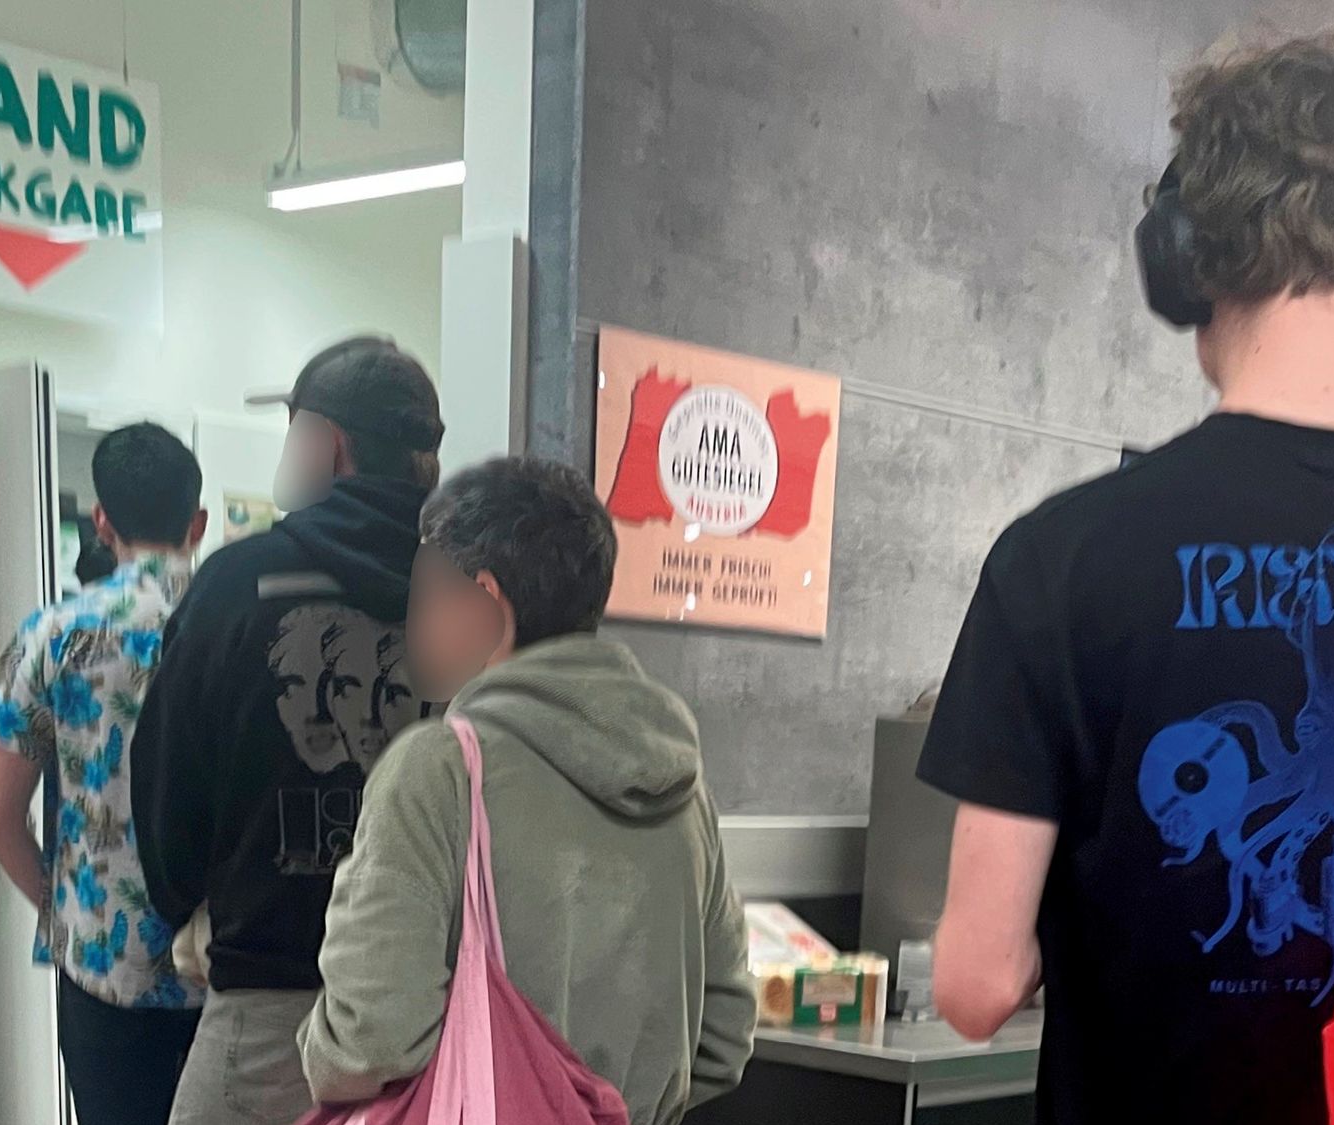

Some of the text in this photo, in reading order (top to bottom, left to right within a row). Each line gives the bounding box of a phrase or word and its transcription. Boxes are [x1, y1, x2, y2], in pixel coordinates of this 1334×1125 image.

[698, 422, 741, 461] AMA
[662, 547, 712, 575] IMMER
[653, 573, 703, 598] IMMER
